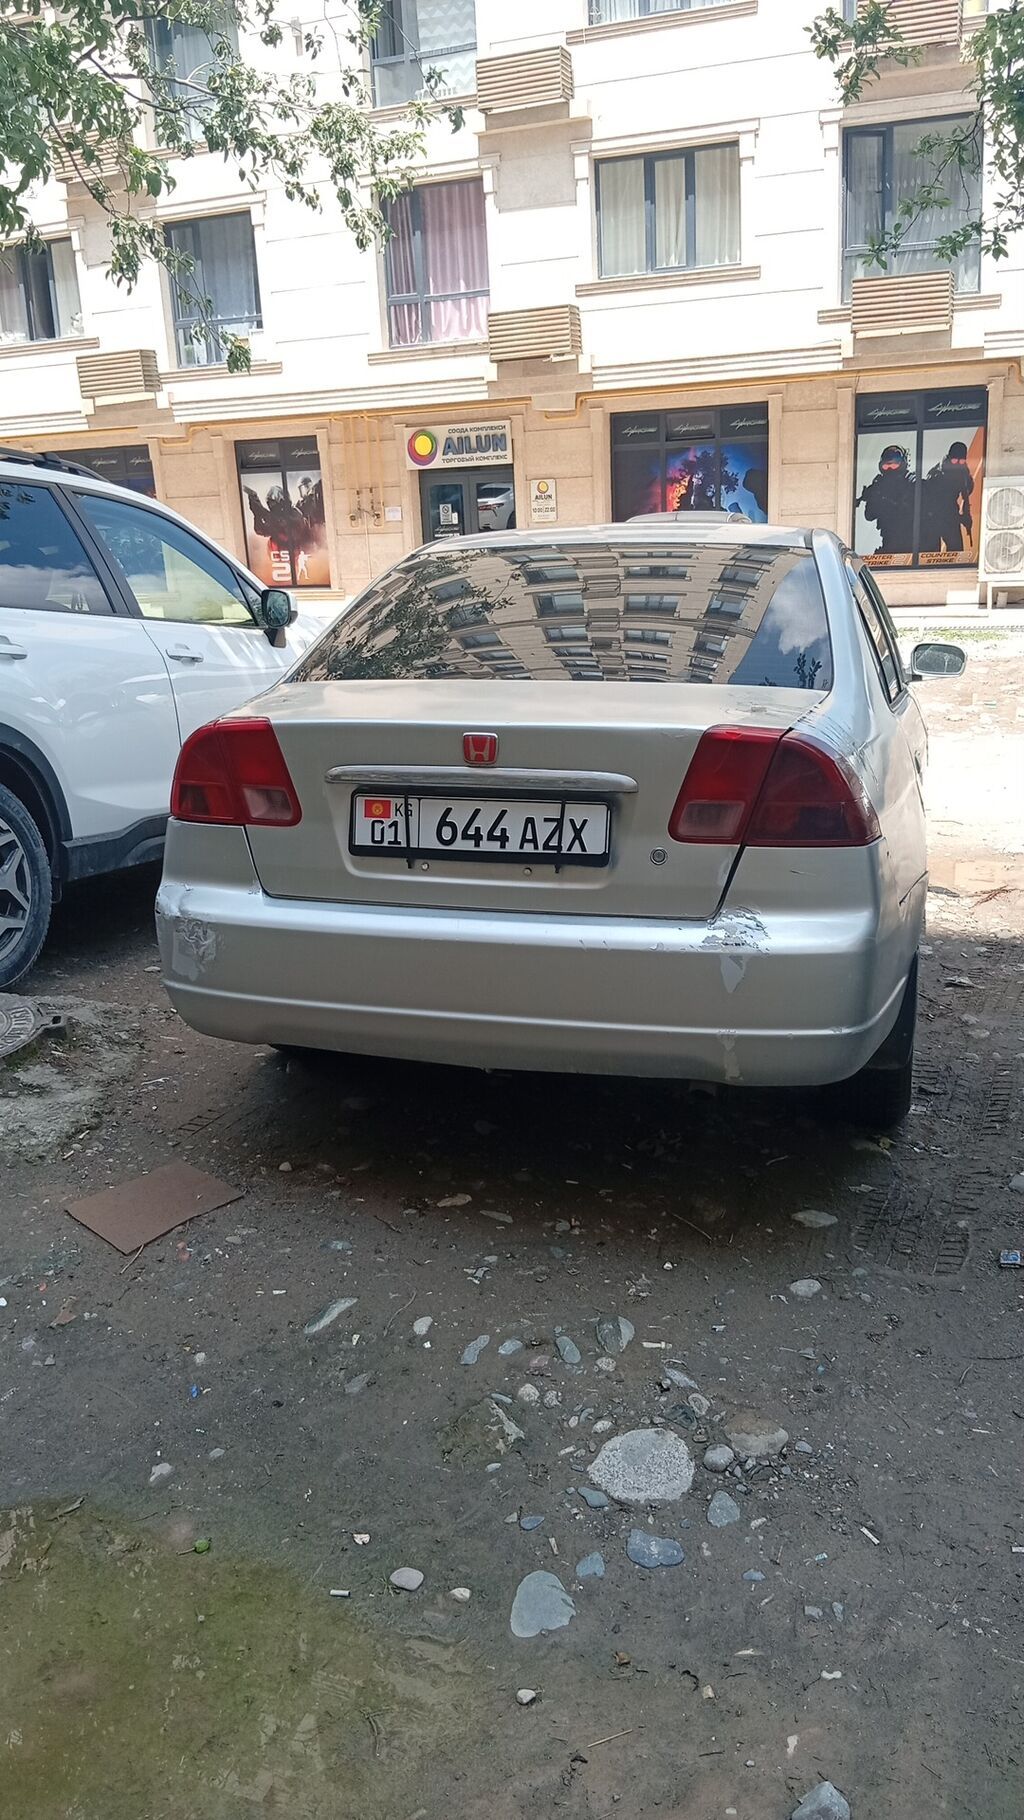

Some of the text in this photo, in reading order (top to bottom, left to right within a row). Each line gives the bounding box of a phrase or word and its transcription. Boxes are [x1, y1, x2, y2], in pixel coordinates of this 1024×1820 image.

[443, 434, 507, 456] AILUN
[441, 454, 508, 464] ТОРГОВЫЙ КОМПЛЕКС
[270, 550, 290, 562] CS
[271, 562, 292, 582] 2
[394, 802, 413, 817] KG
[370, 819, 401, 846] 01
